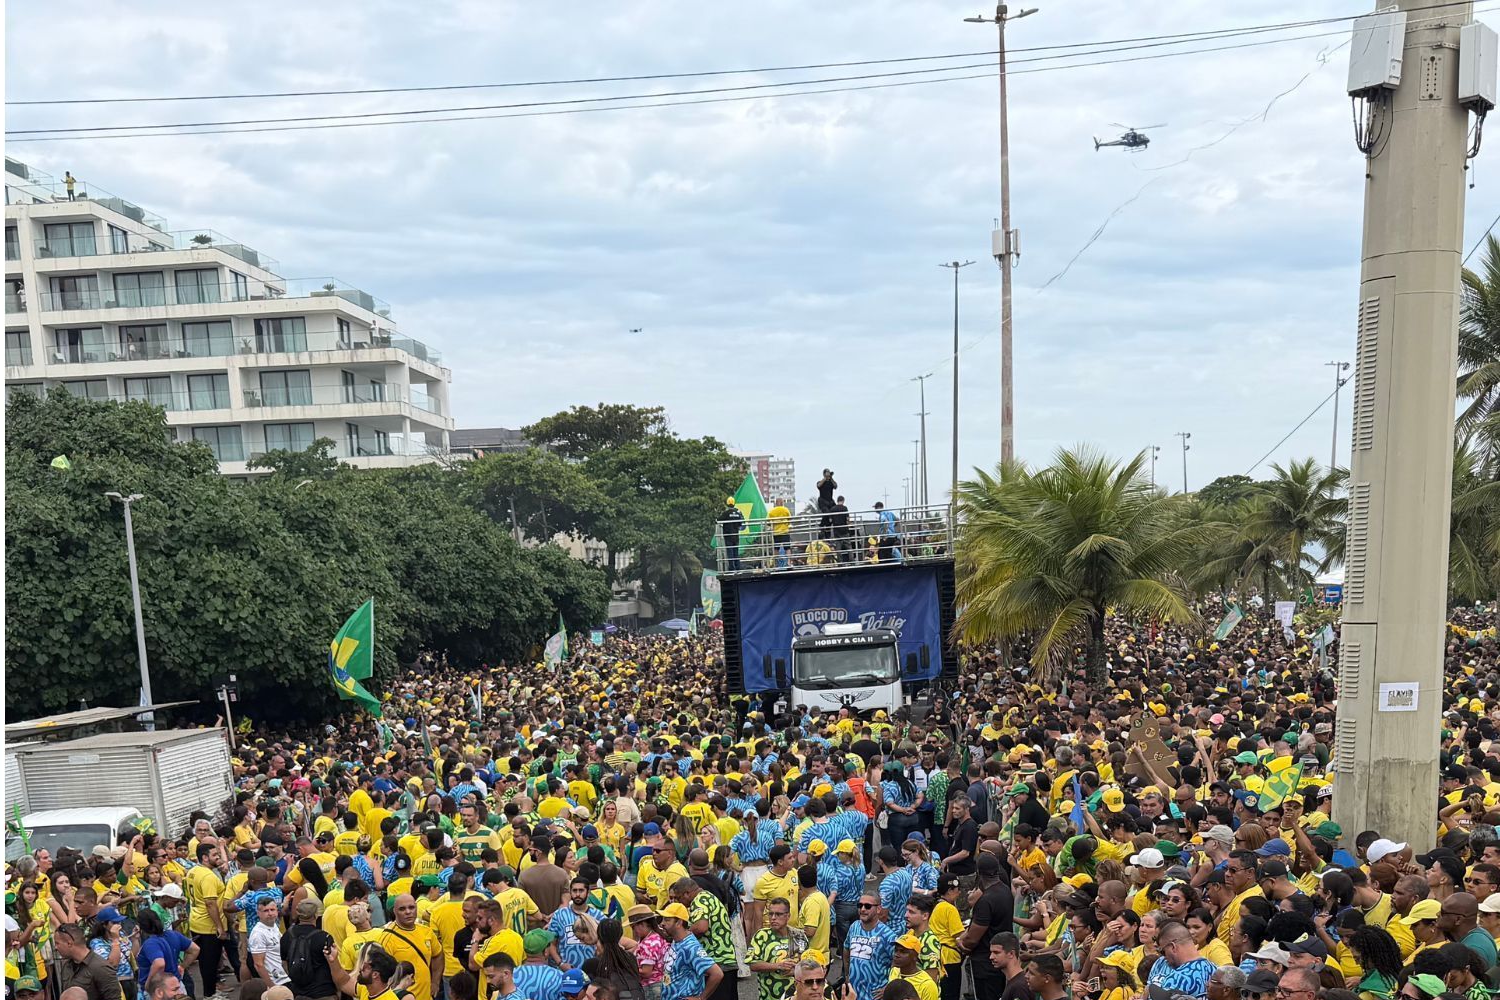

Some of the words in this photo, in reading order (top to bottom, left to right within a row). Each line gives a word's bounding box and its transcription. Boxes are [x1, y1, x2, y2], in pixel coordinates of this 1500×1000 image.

[795, 610, 827, 624] BLOCO
[830, 608, 845, 622] DO
[815, 638, 842, 646] HOBBY
[850, 944, 875, 960] 22
